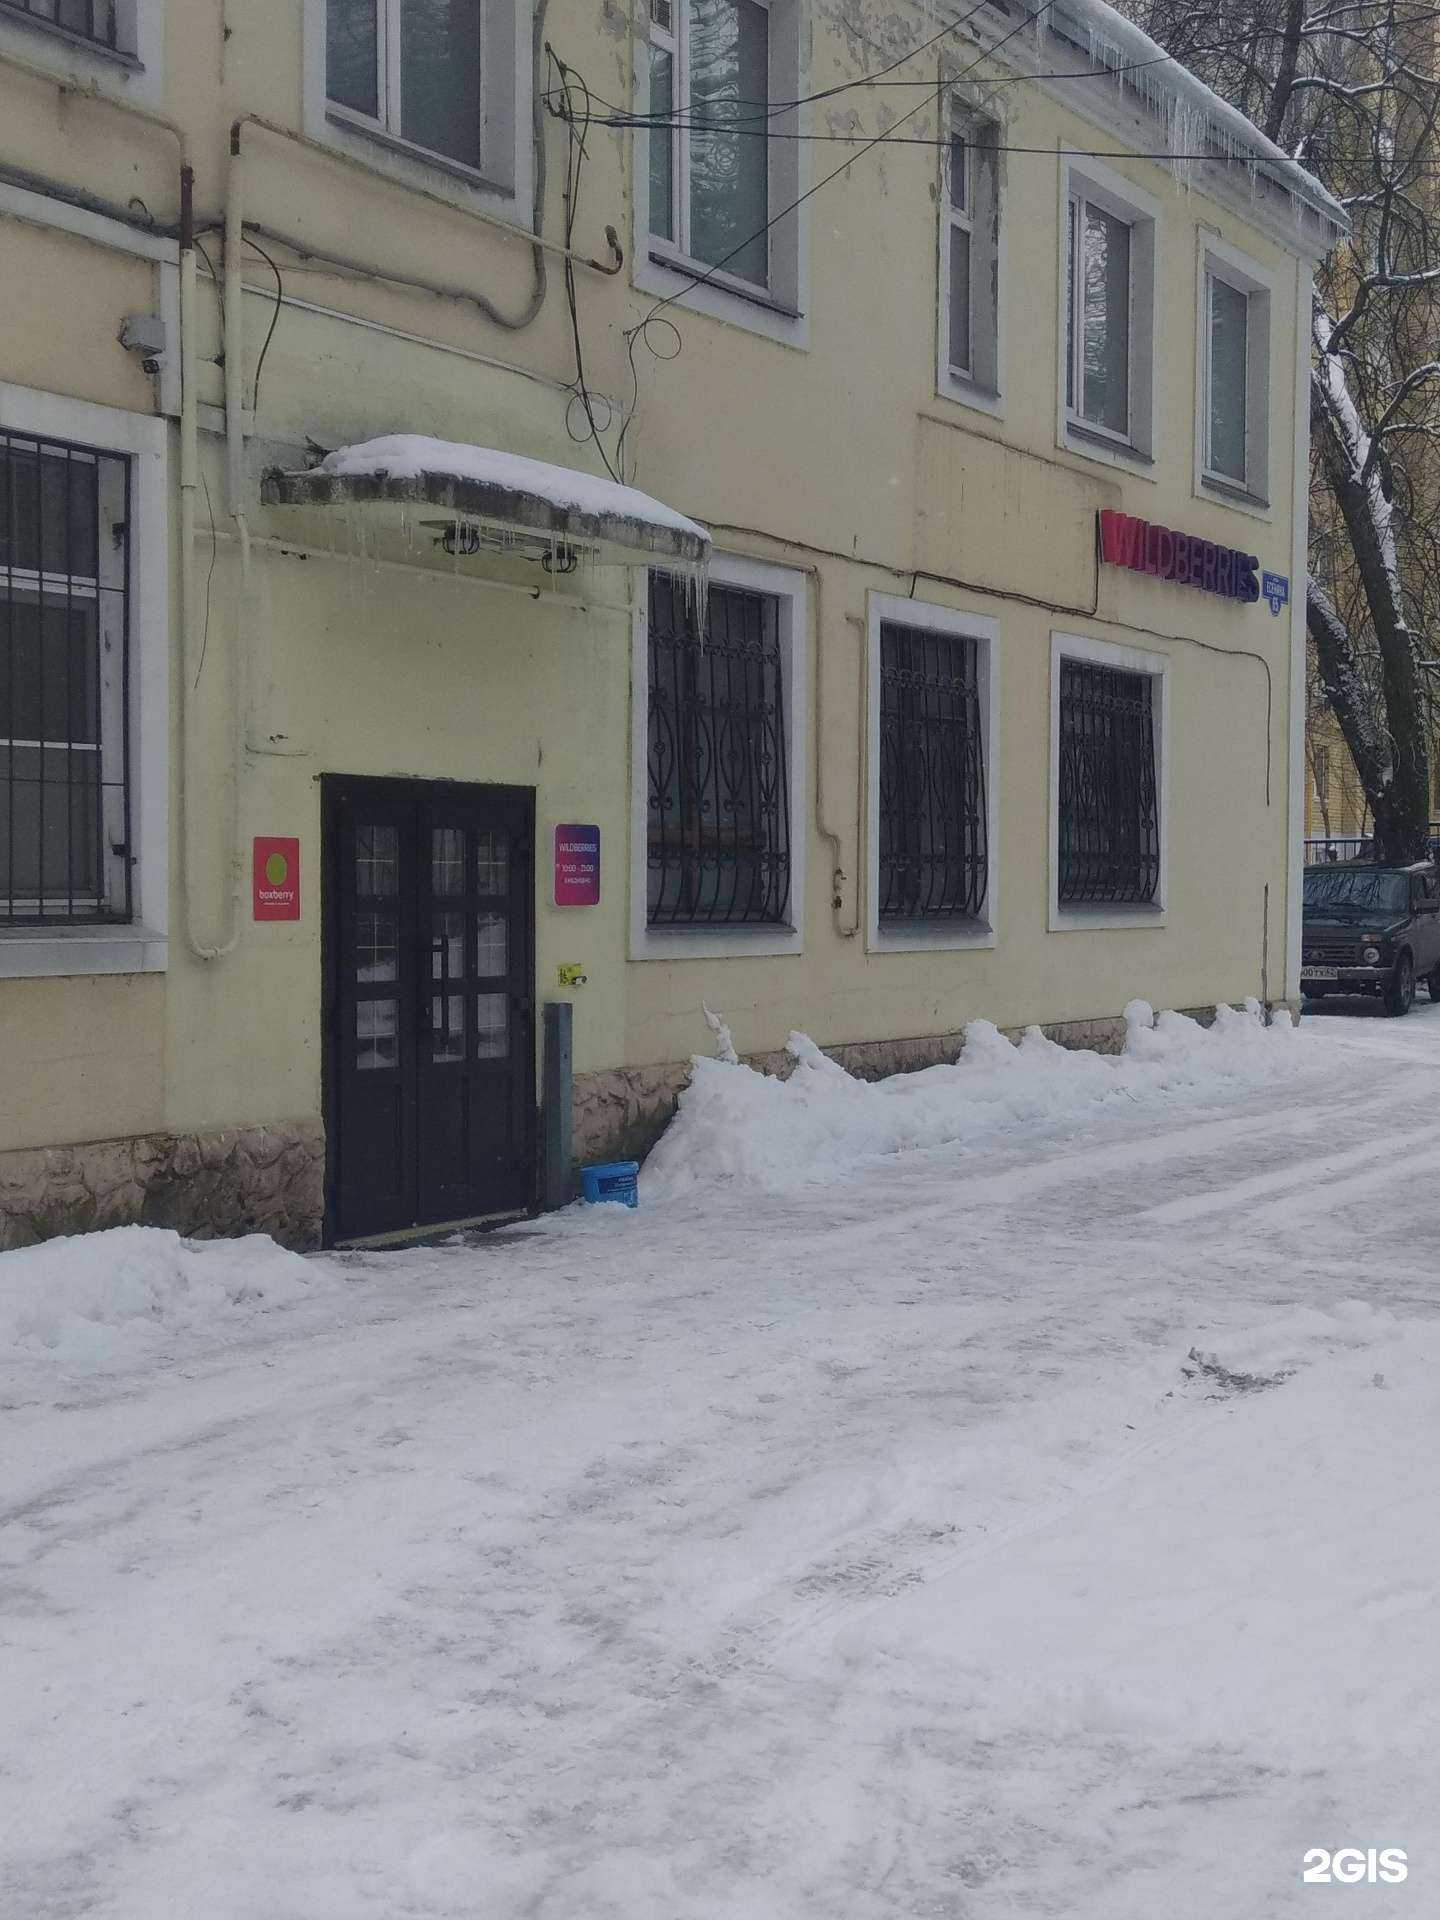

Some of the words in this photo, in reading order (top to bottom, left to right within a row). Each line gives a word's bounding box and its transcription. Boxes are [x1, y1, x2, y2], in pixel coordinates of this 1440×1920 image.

[1100, 509, 1260, 603] WILDBERRIES
[559, 842, 597, 853] WILDBERRIES
[258, 889, 295, 902] boxberry
